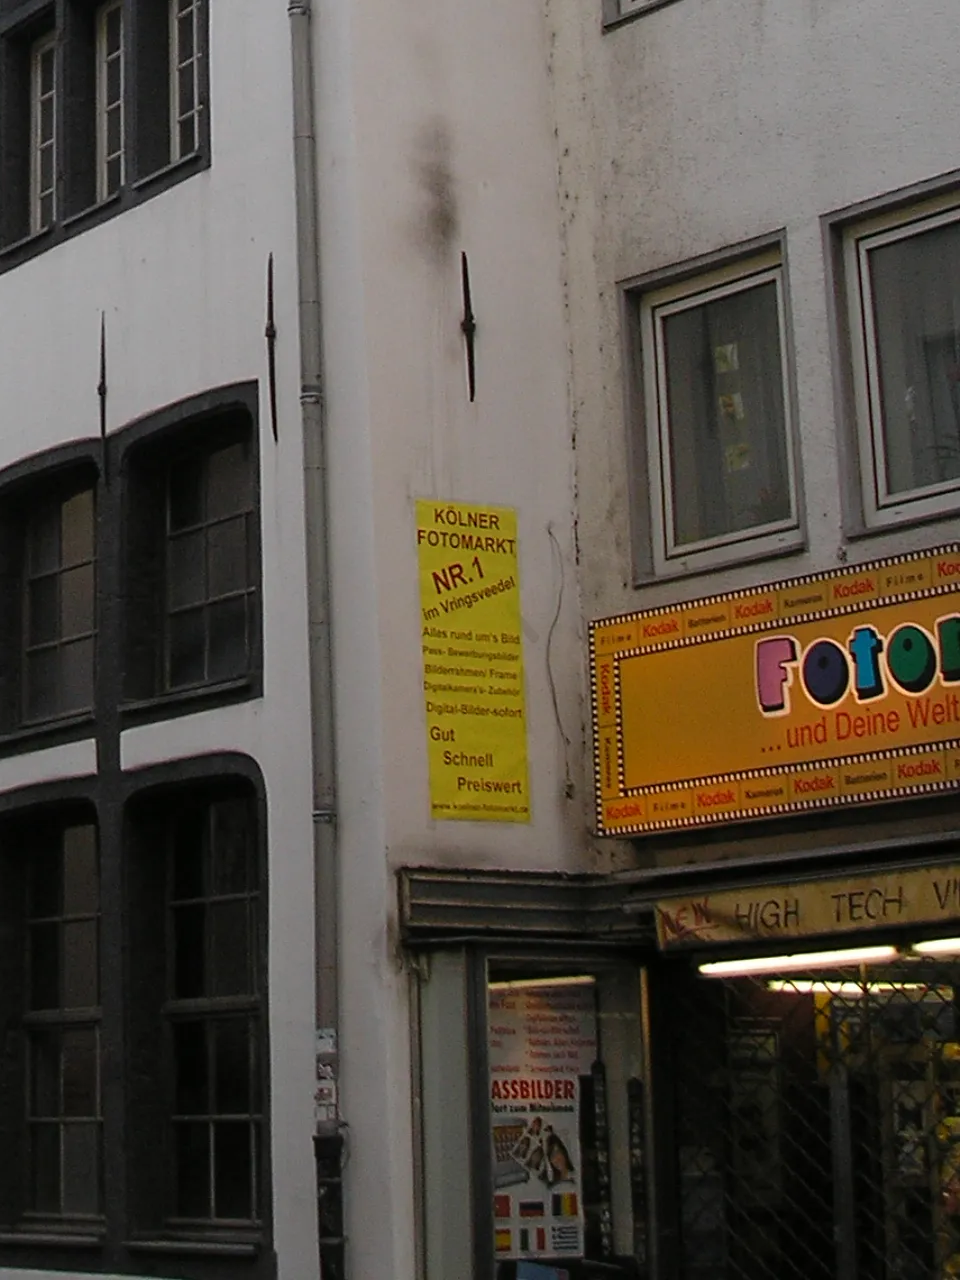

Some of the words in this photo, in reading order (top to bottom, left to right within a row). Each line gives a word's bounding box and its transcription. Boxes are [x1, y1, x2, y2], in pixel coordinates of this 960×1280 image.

[434, 506, 500, 530] KÖLNER
[417, 529, 516, 555] FOTOMARKT
[422, 608, 440, 621] im
[440, 576, 516, 613] Vringsveedel
[643, 620, 679, 638] Kodak
[734, 599, 773, 619] Kodak
[833, 578, 875, 599] Kodak
[423, 626, 447, 638] Alles
[450, 630, 472, 641] rund
[501, 633, 520, 644] Bild
[600, 663, 610, 715] Kodak
[430, 726, 455, 742] Gut
[836, 708, 900, 740] Deine
[443, 750, 493, 767] Schnell
[457, 776, 522, 794] Preiswert
[606, 803, 642, 820] Kodak
[696, 790, 736, 807] Kodak
[794, 775, 834, 794] Kodak
[898, 759, 942, 779] Kodak
[734, 899, 800, 932] HIGH
[831, 886, 903, 923] TECH
